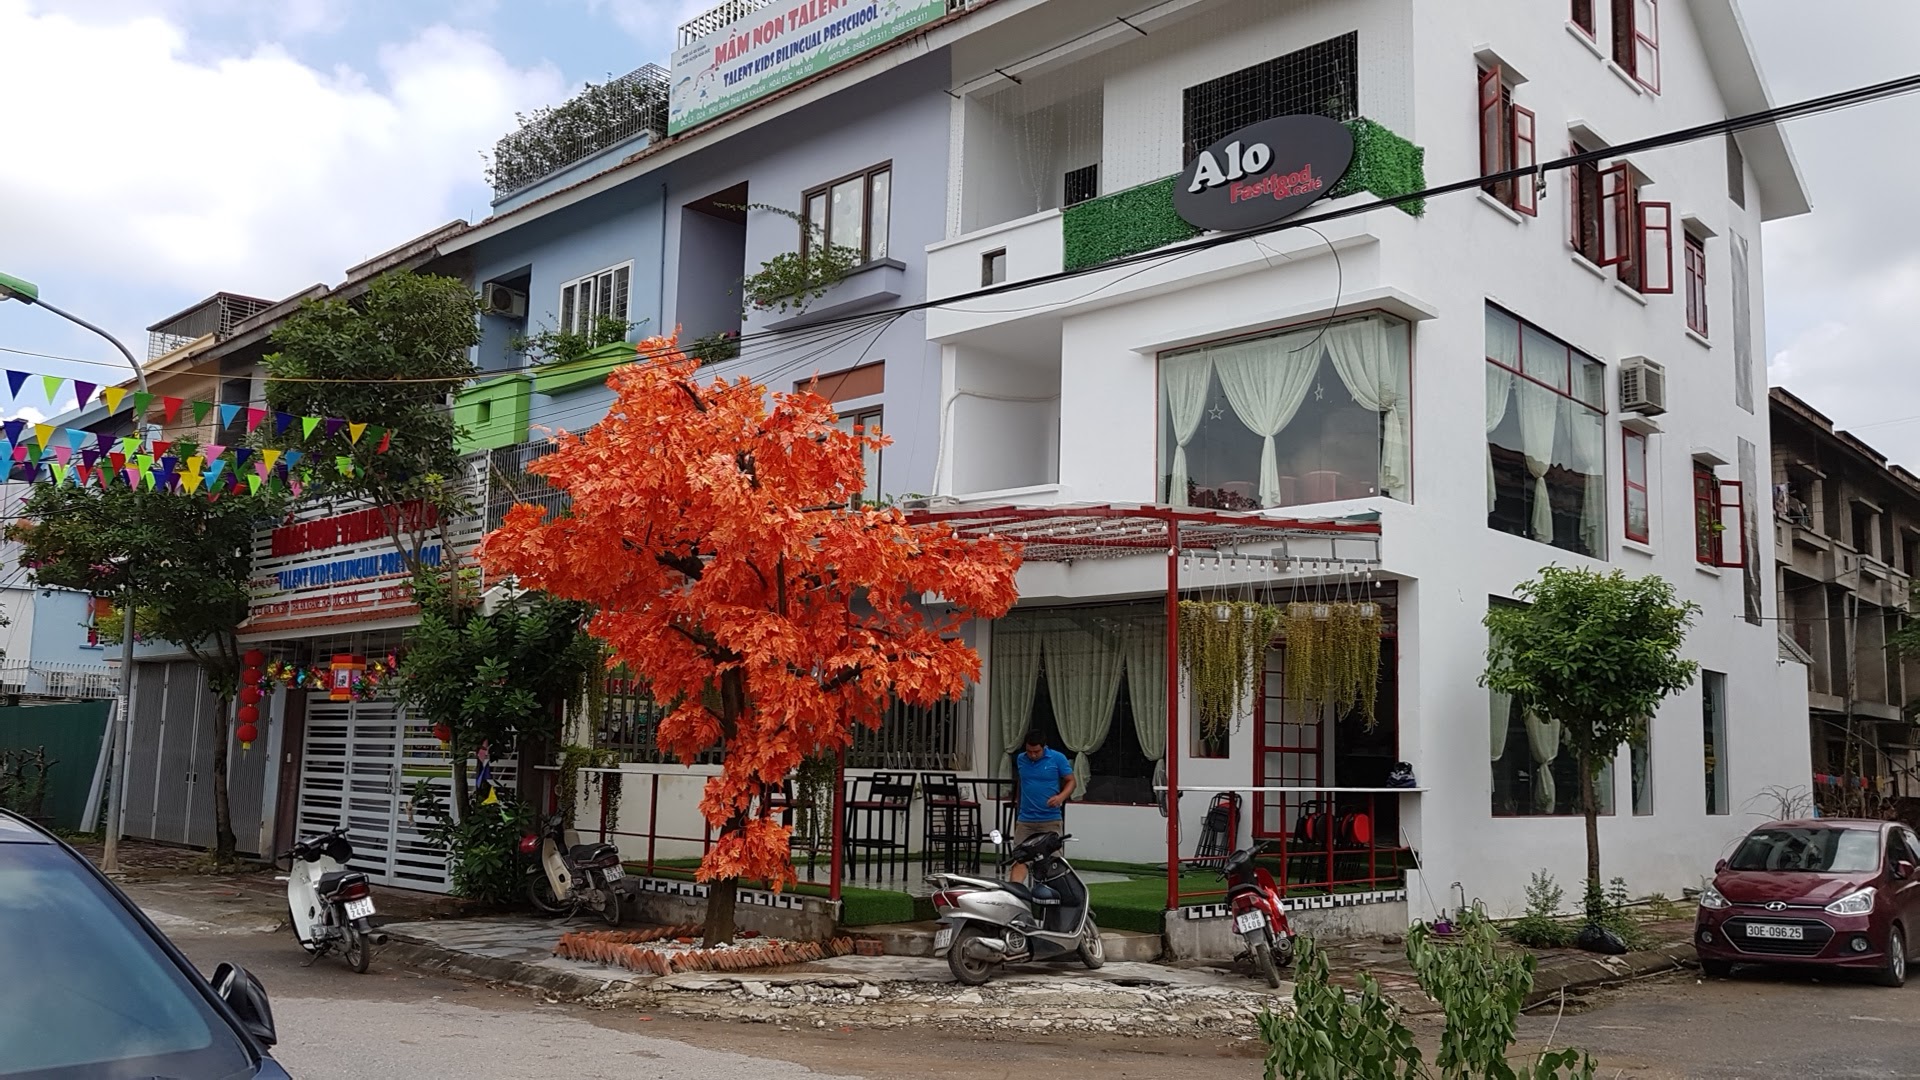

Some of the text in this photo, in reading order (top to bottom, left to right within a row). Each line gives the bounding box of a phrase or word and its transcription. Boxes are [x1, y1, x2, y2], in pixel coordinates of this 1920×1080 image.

[715, 27, 750, 66] MẦM
[753, 15, 785, 49] NON
[724, 4, 878, 87] TALENT KIDS BILINGUAL PRESCHOOL
[1187, 140, 1272, 194] Alo
[1230, 163, 1312, 204] Fastfood
[332, 555, 380, 584] BILINGUAL
[1747, 925, 1802, 939] 30E-096.25
